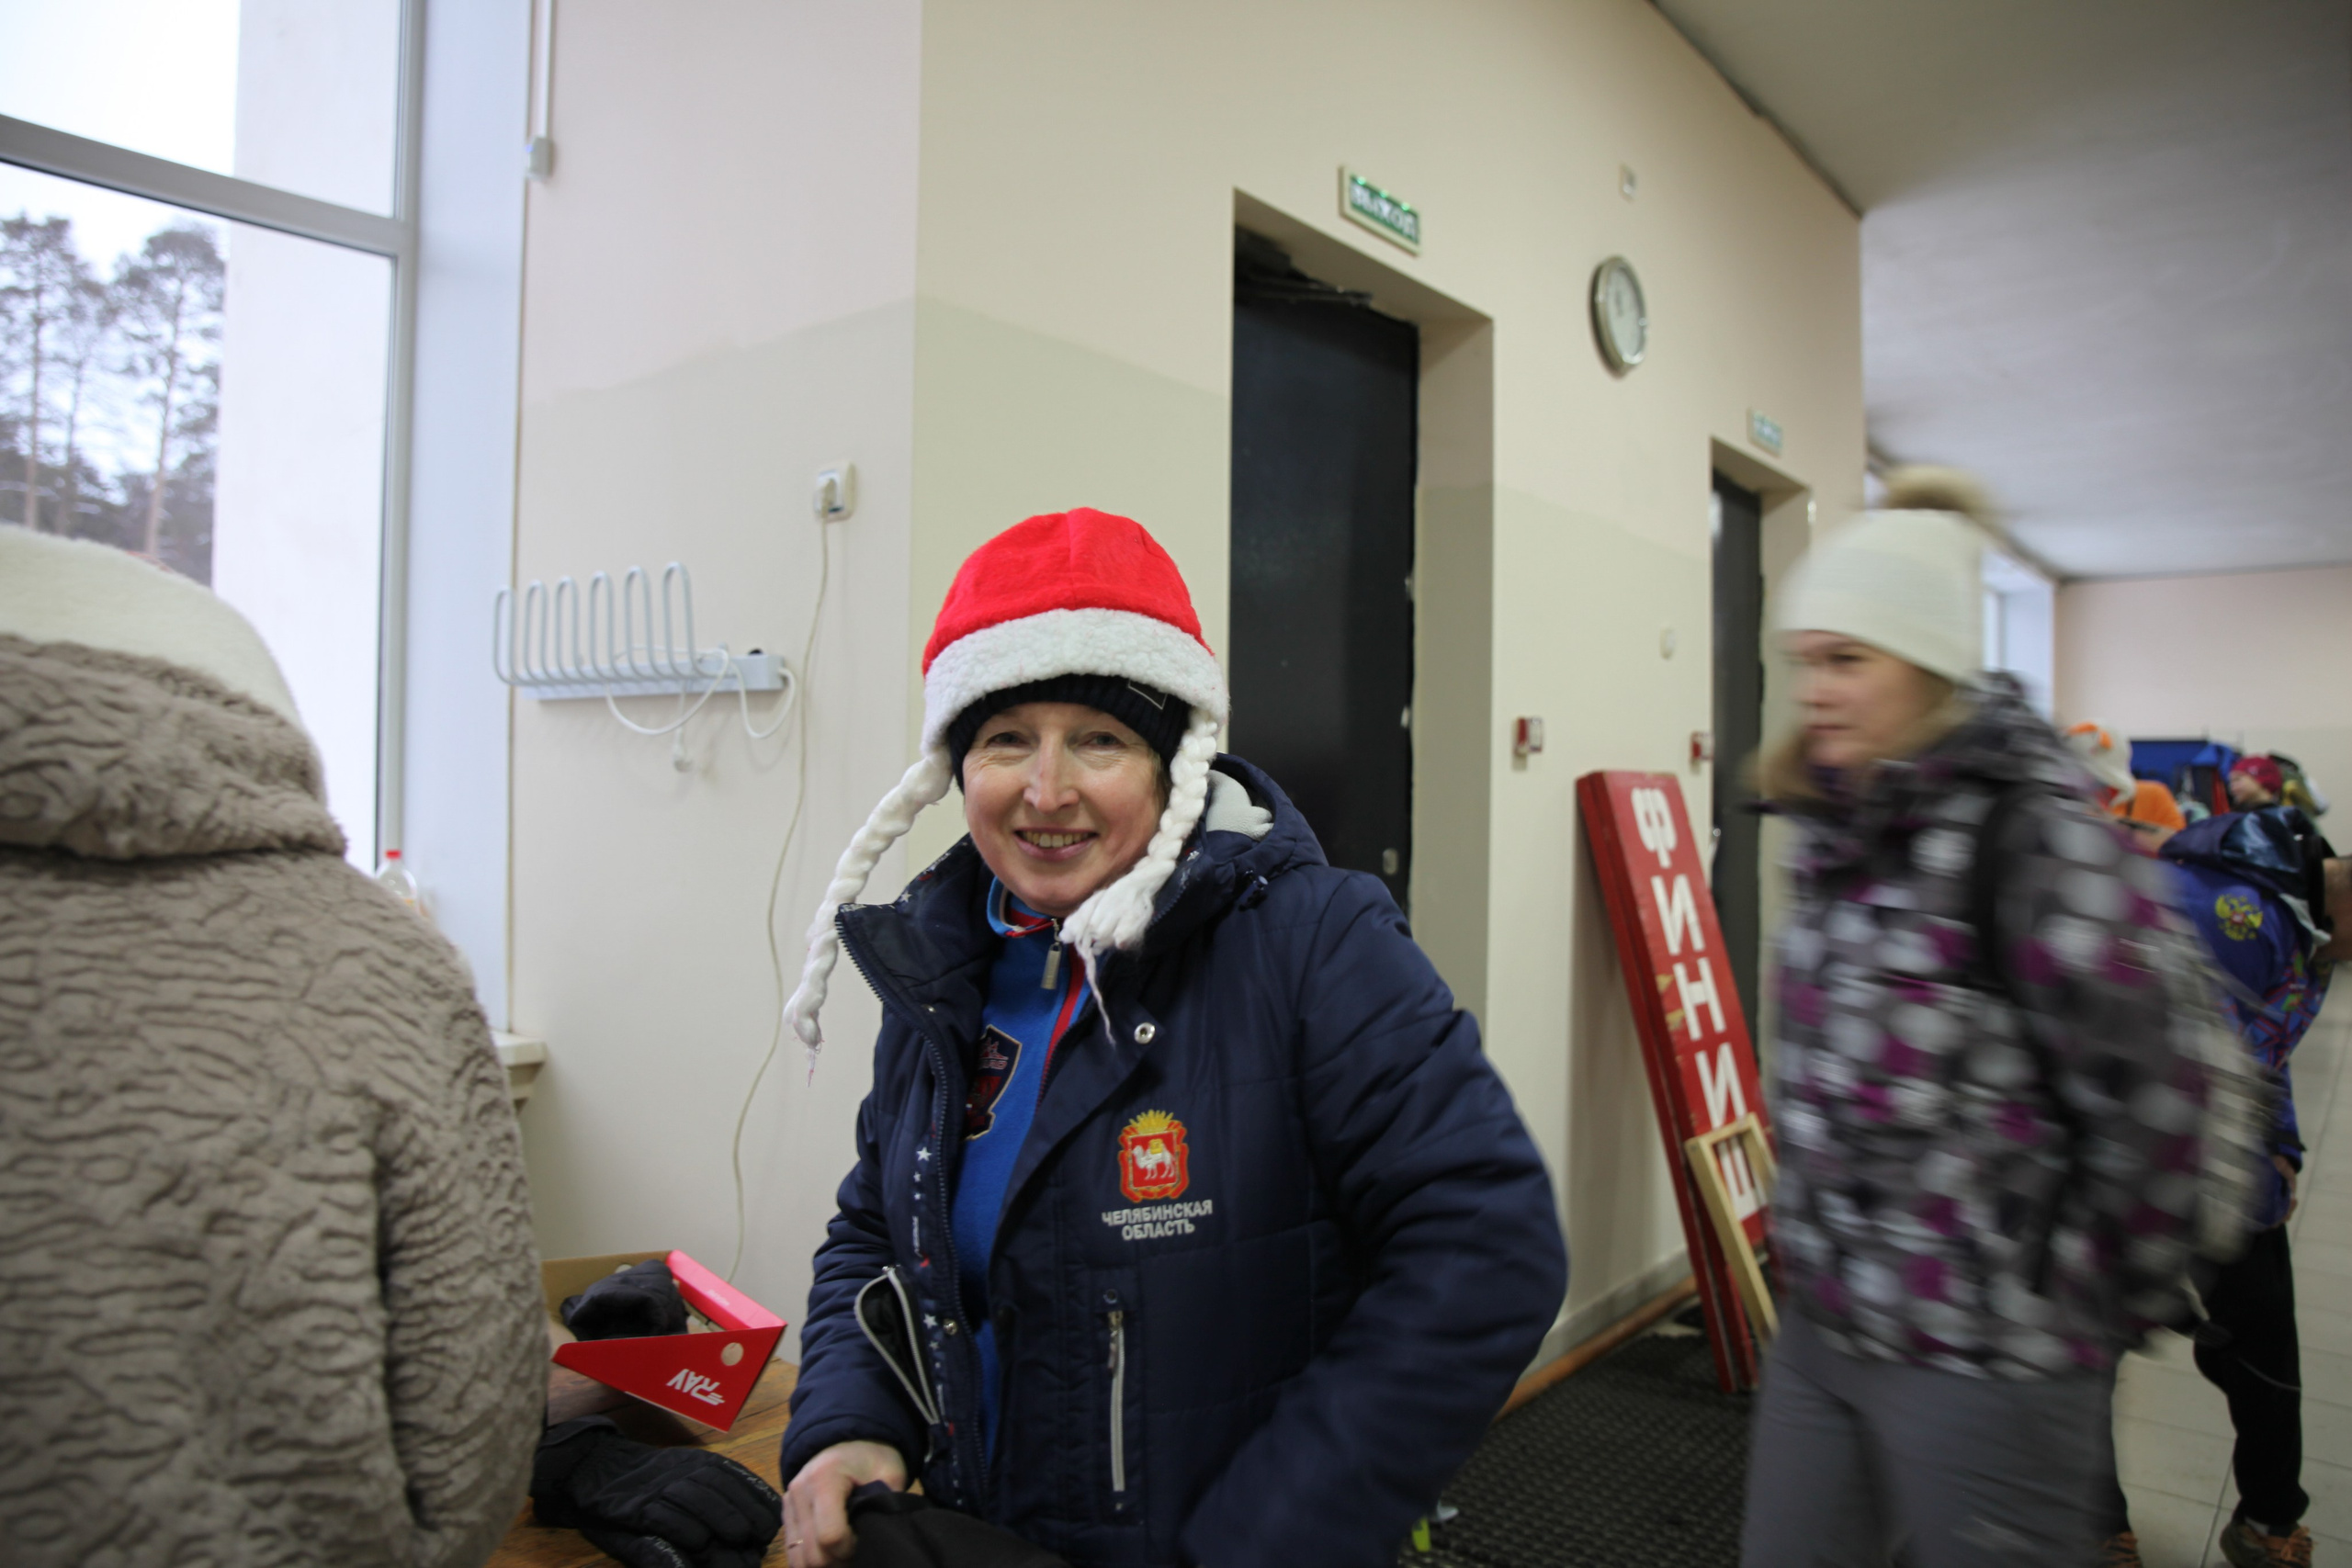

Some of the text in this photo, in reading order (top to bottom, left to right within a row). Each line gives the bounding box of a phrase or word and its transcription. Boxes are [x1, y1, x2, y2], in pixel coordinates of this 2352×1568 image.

[1102, 1199, 1213, 1226] ЧЕЛЯБИНСКАЯ
[1121, 1218, 1195, 1240] ОБЛАСТЬ
[666, 1369, 725, 1405] RAY
